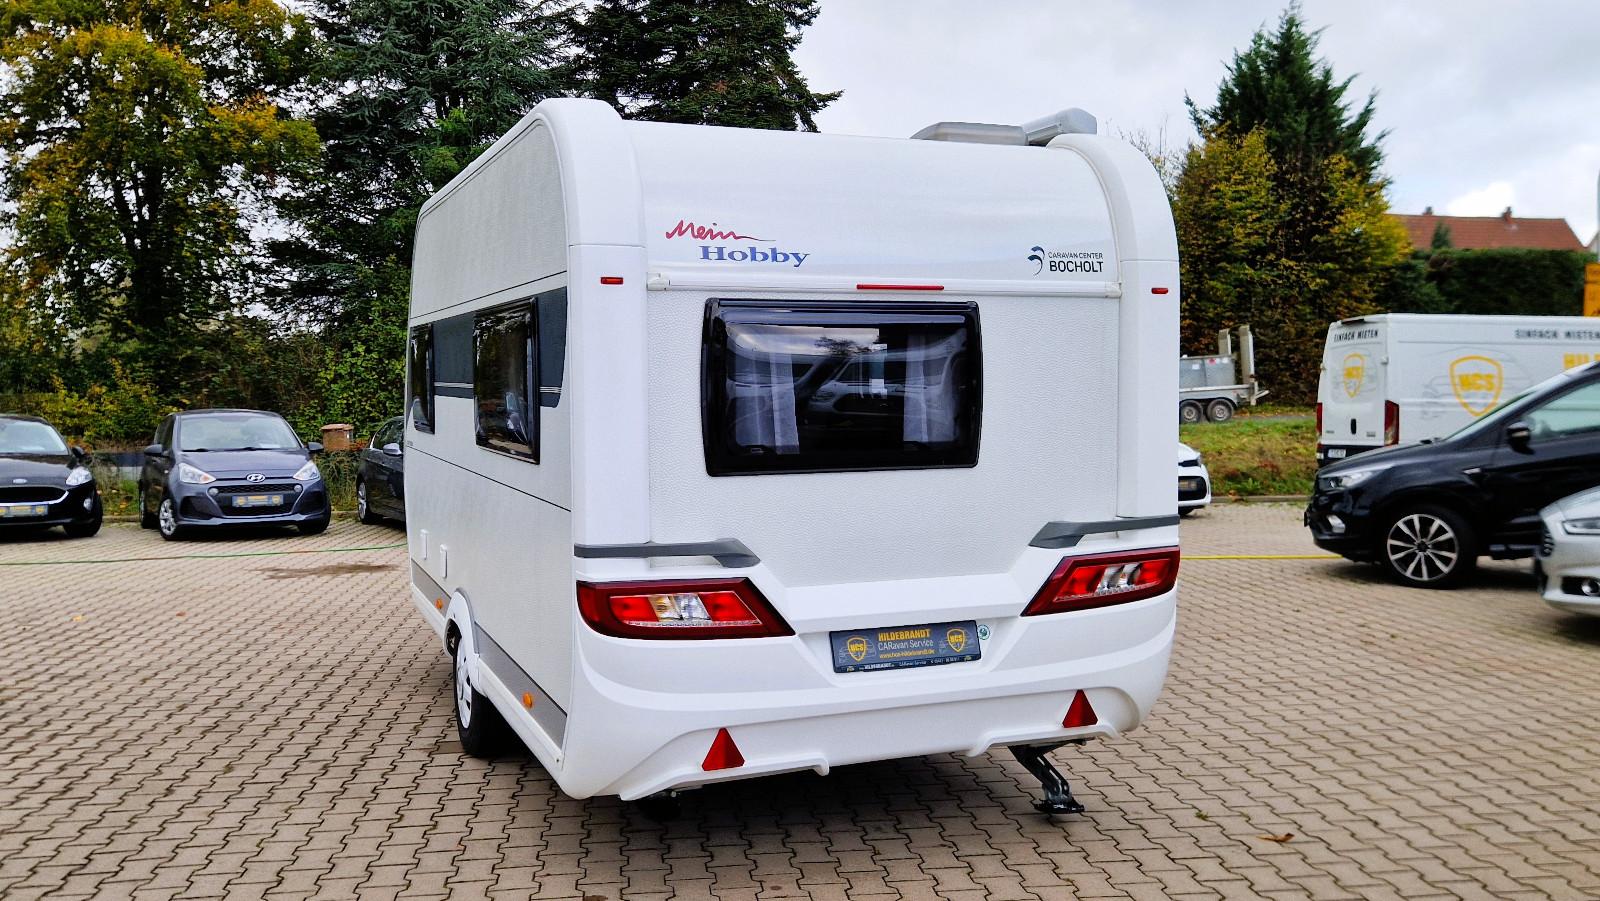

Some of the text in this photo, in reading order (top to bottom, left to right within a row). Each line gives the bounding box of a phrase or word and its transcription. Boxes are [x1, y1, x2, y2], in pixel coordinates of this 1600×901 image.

[665, 219, 776, 242] Mein
[698, 245, 811, 268] Hobby
[1048, 251, 1078, 259] CARAVAN
[1049, 260, 1104, 273] BOCHOLT
[1334, 329, 1379, 343] EINFACH MIETEN
[879, 629, 930, 641] HILDEBRANDT
[878, 637, 934, 651] CARavan Service
